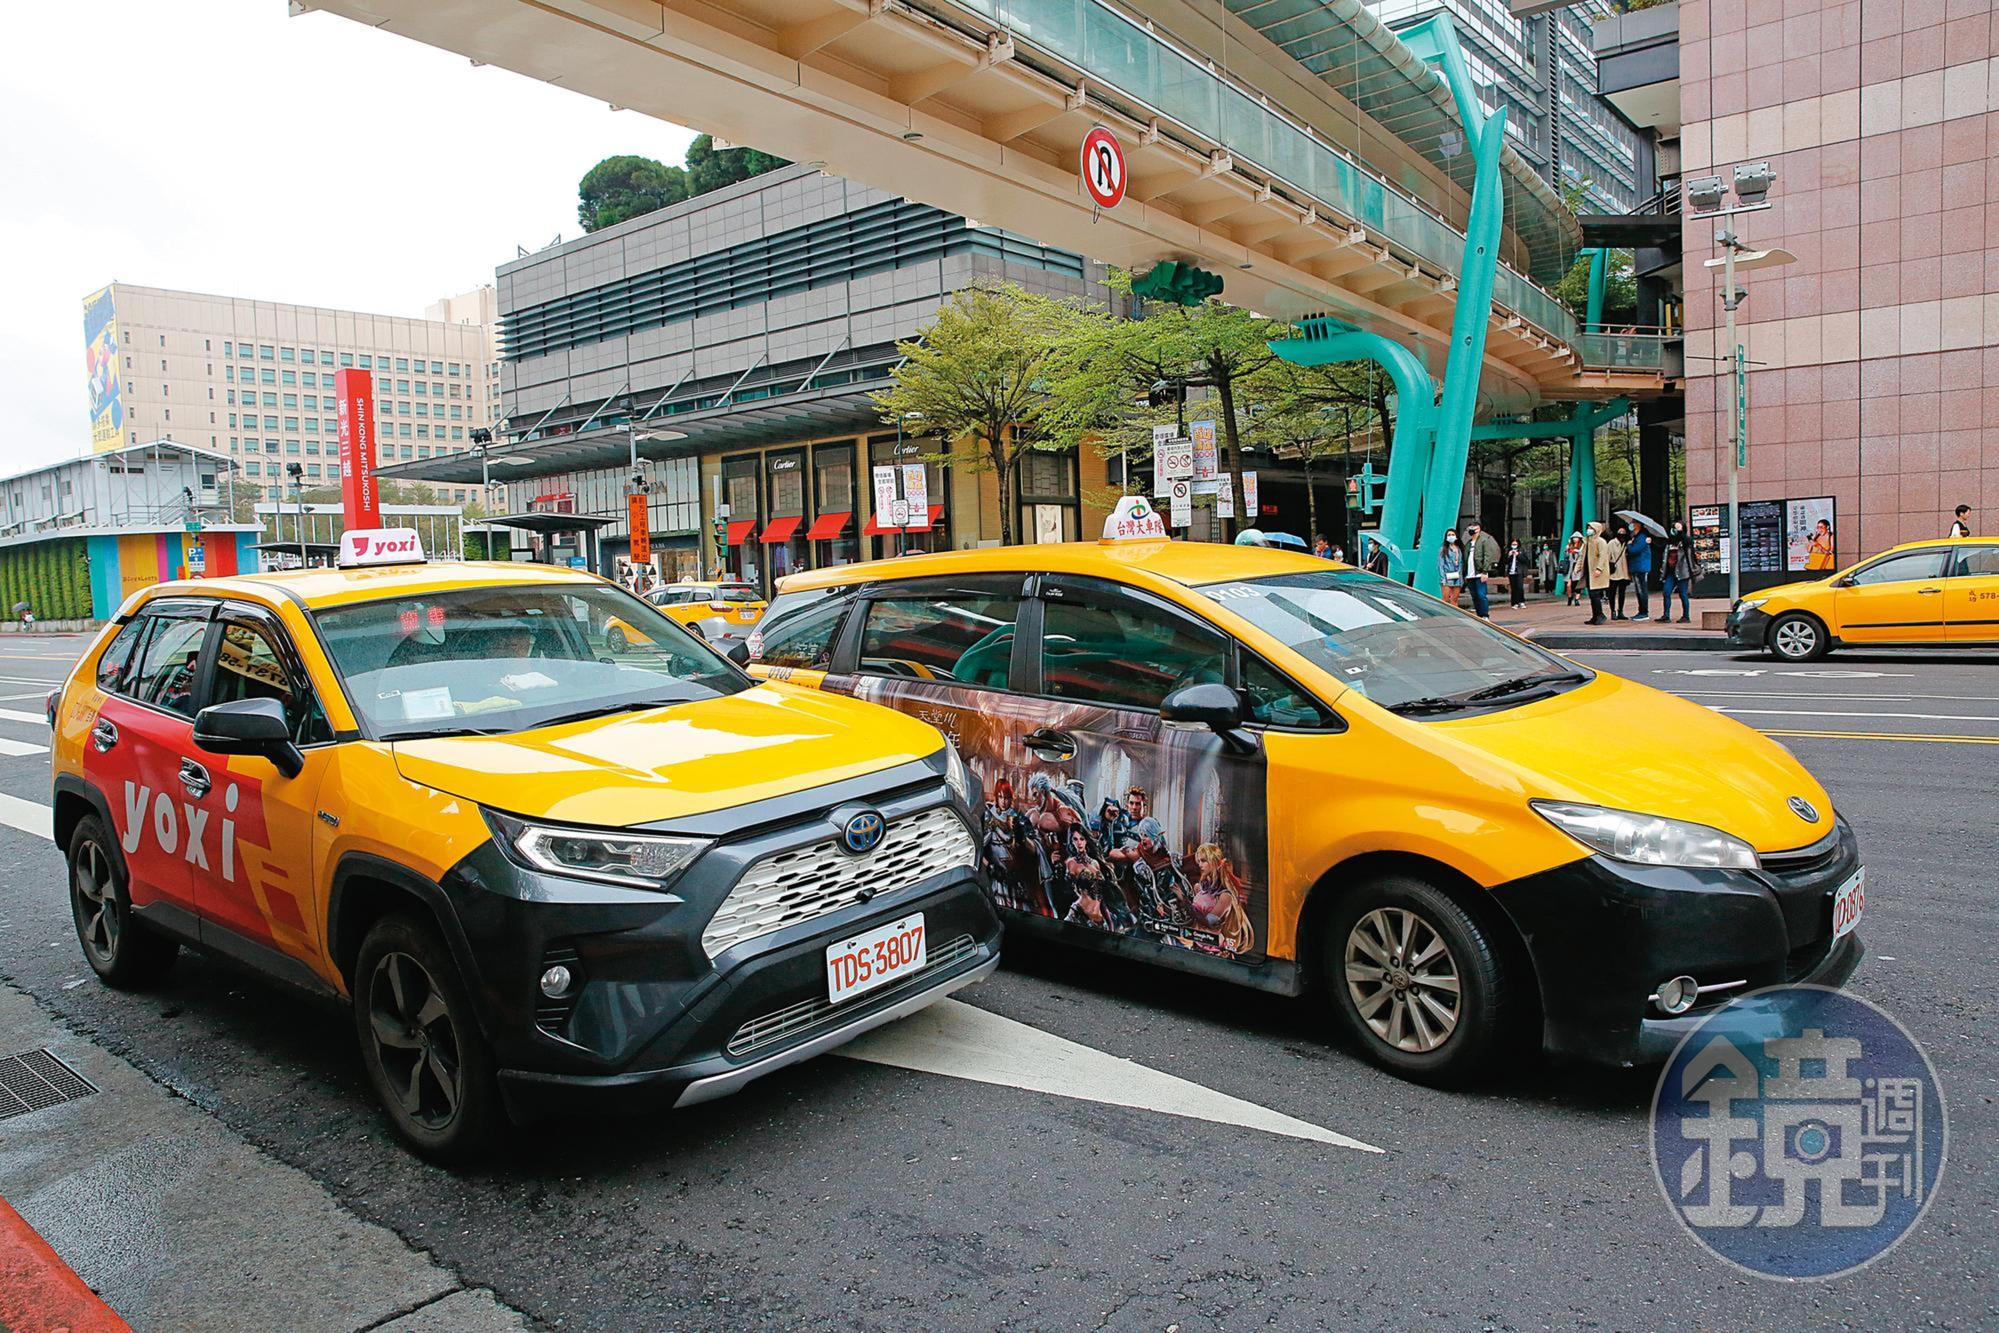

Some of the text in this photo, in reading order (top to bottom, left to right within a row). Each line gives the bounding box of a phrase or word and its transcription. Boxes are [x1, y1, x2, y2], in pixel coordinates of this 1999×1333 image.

[338, 399, 352, 477] 新光三越
[356, 398, 371, 512] SHIN KONG MITSUKOSHI
[773, 459, 796, 470] Cartier
[1117, 518, 1164, 536] 台灣大車隊
[374, 535, 416, 557] yoxi
[1205, 585, 1260, 601] 0103
[767, 666, 794, 680] 0103
[122, 780, 239, 882] yoxi
[830, 926, 923, 992] TDS-3807
